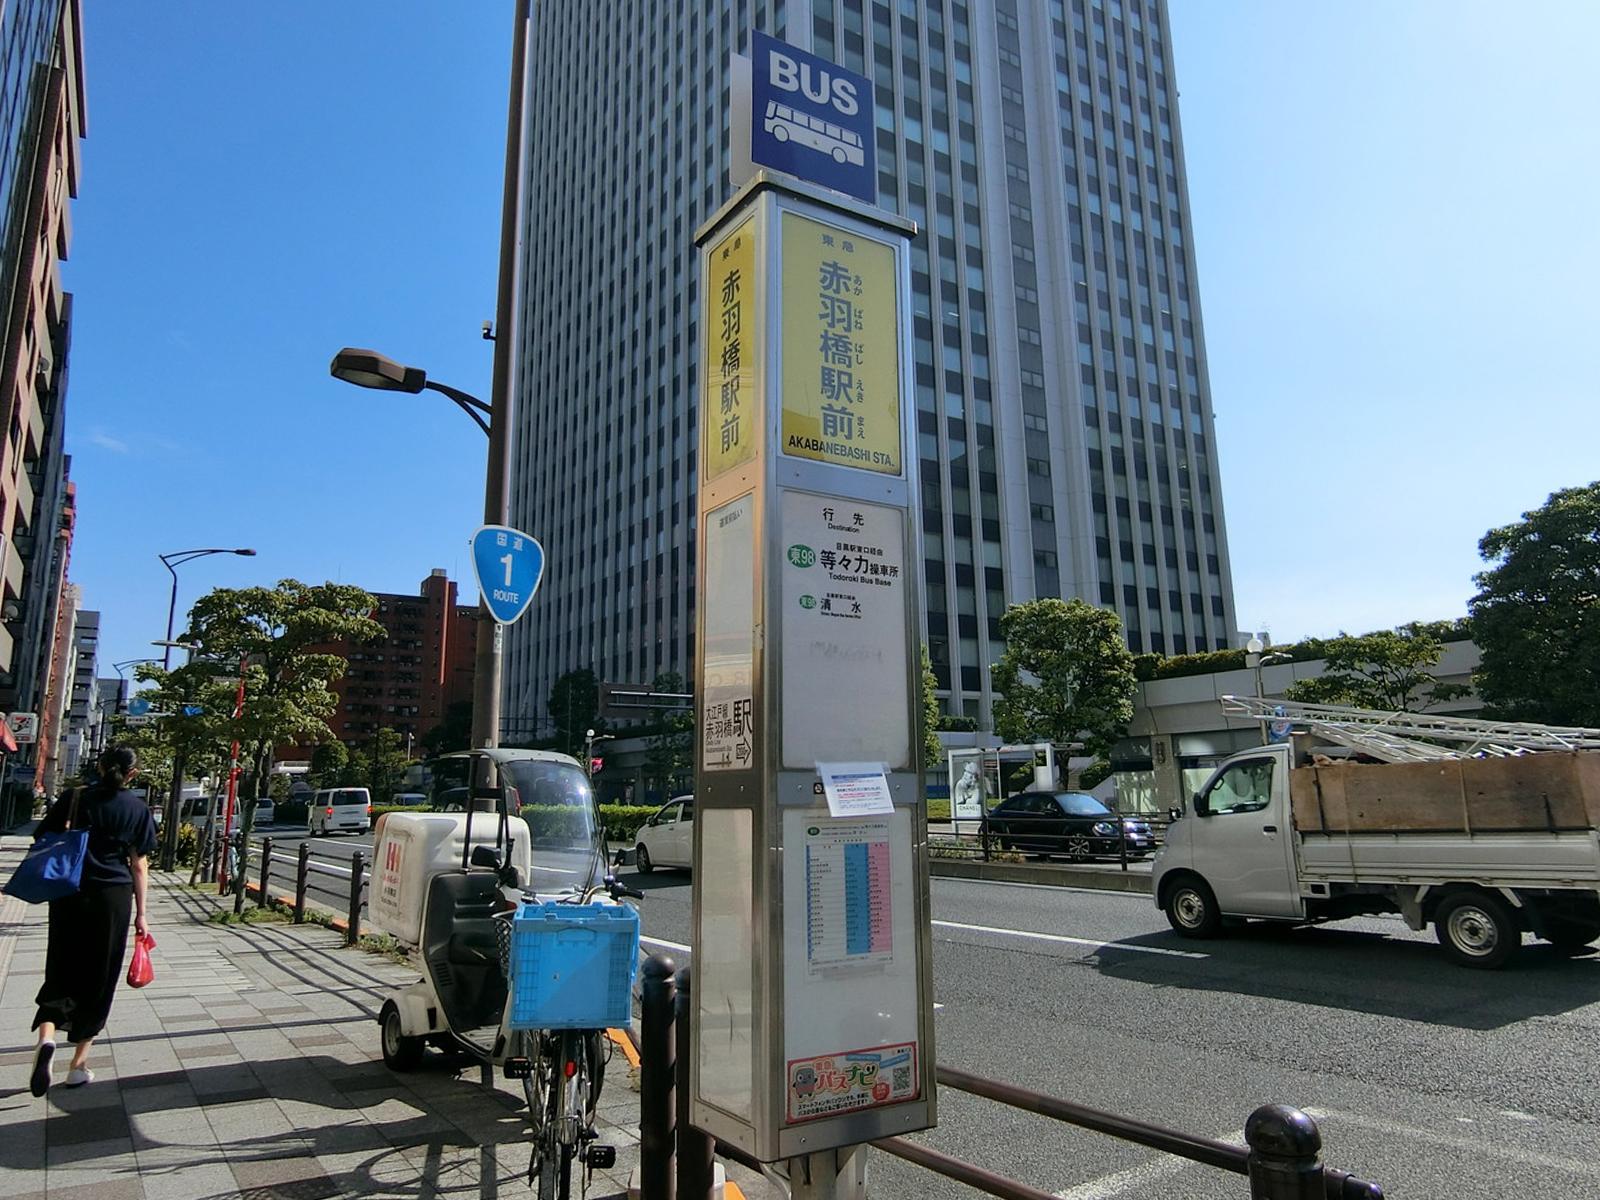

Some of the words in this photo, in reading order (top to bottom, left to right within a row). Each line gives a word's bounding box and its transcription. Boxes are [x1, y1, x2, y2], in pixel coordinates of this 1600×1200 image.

[769, 50, 859, 116] BUS
[821, 233, 855, 253] 東急
[720, 268, 742, 455] 赤羽橋駅前
[818, 261, 855, 441] 赤羽橋駅前
[788, 434, 871, 463] AKABANEBASHI
[873, 451, 896, 467] STA.
[822, 507, 865, 527] 行先
[827, 522, 860, 534] Destination
[496, 531, 524, 552] 国道
[790, 547, 815, 566] 東98
[820, 549, 899, 578] 等々力操車所
[500, 553, 513, 587] 1
[828, 571, 859, 583] Todoroki
[860, 576, 874, 585] Bus
[875, 578, 892, 587] Base
[493, 589, 520, 604] ROUTE
[820, 598, 862, 614] 清水
[733, 699, 753, 737] 駅
[815, 1062, 877, 1091] バスナビ
